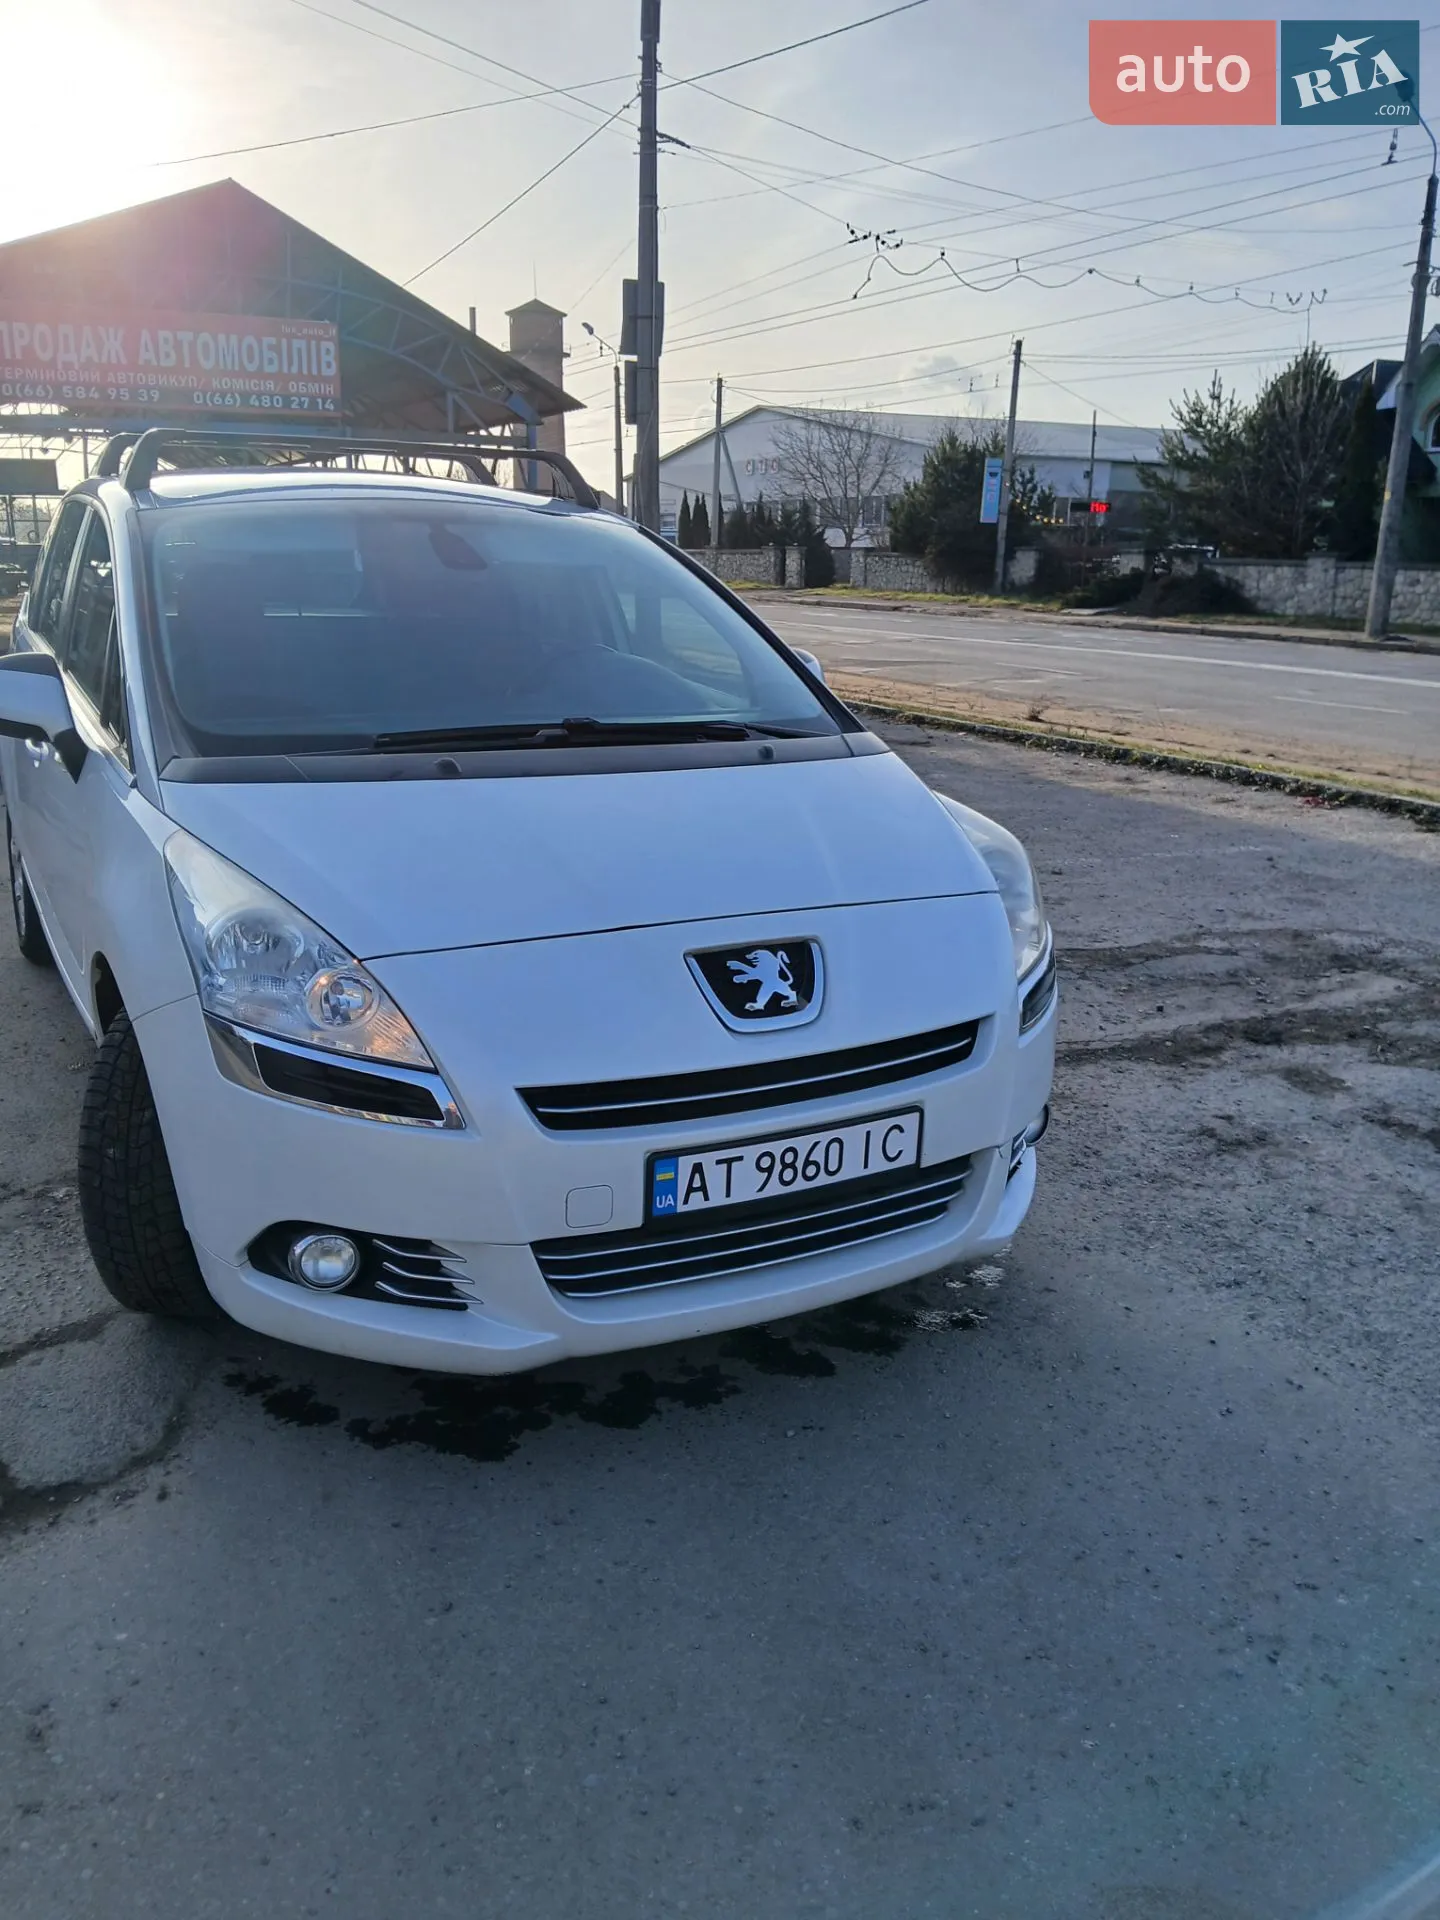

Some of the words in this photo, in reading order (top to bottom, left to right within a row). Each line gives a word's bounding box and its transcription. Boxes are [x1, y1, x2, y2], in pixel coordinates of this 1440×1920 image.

[138, 328, 337, 377] АВТОМОБІЛІВ
[0, 366, 100, 382] ЕРМІНОВИЙ
[289, 381, 334, 395] ОБМІН
[2, 382, 54, 399] 0(66)
[62, 385, 100, 400] 584
[107, 387, 130, 401] 95
[138, 388, 160, 402] 39
[193, 391, 241, 408] 0(66)
[249, 394, 284, 409] 480
[290, 396, 310, 409] 27
[316, 398, 335, 412] 14
[682, 1155, 744, 1205] AT
[755, 1136, 844, 1193] 9860
[656, 1193, 675, 1209] UA
